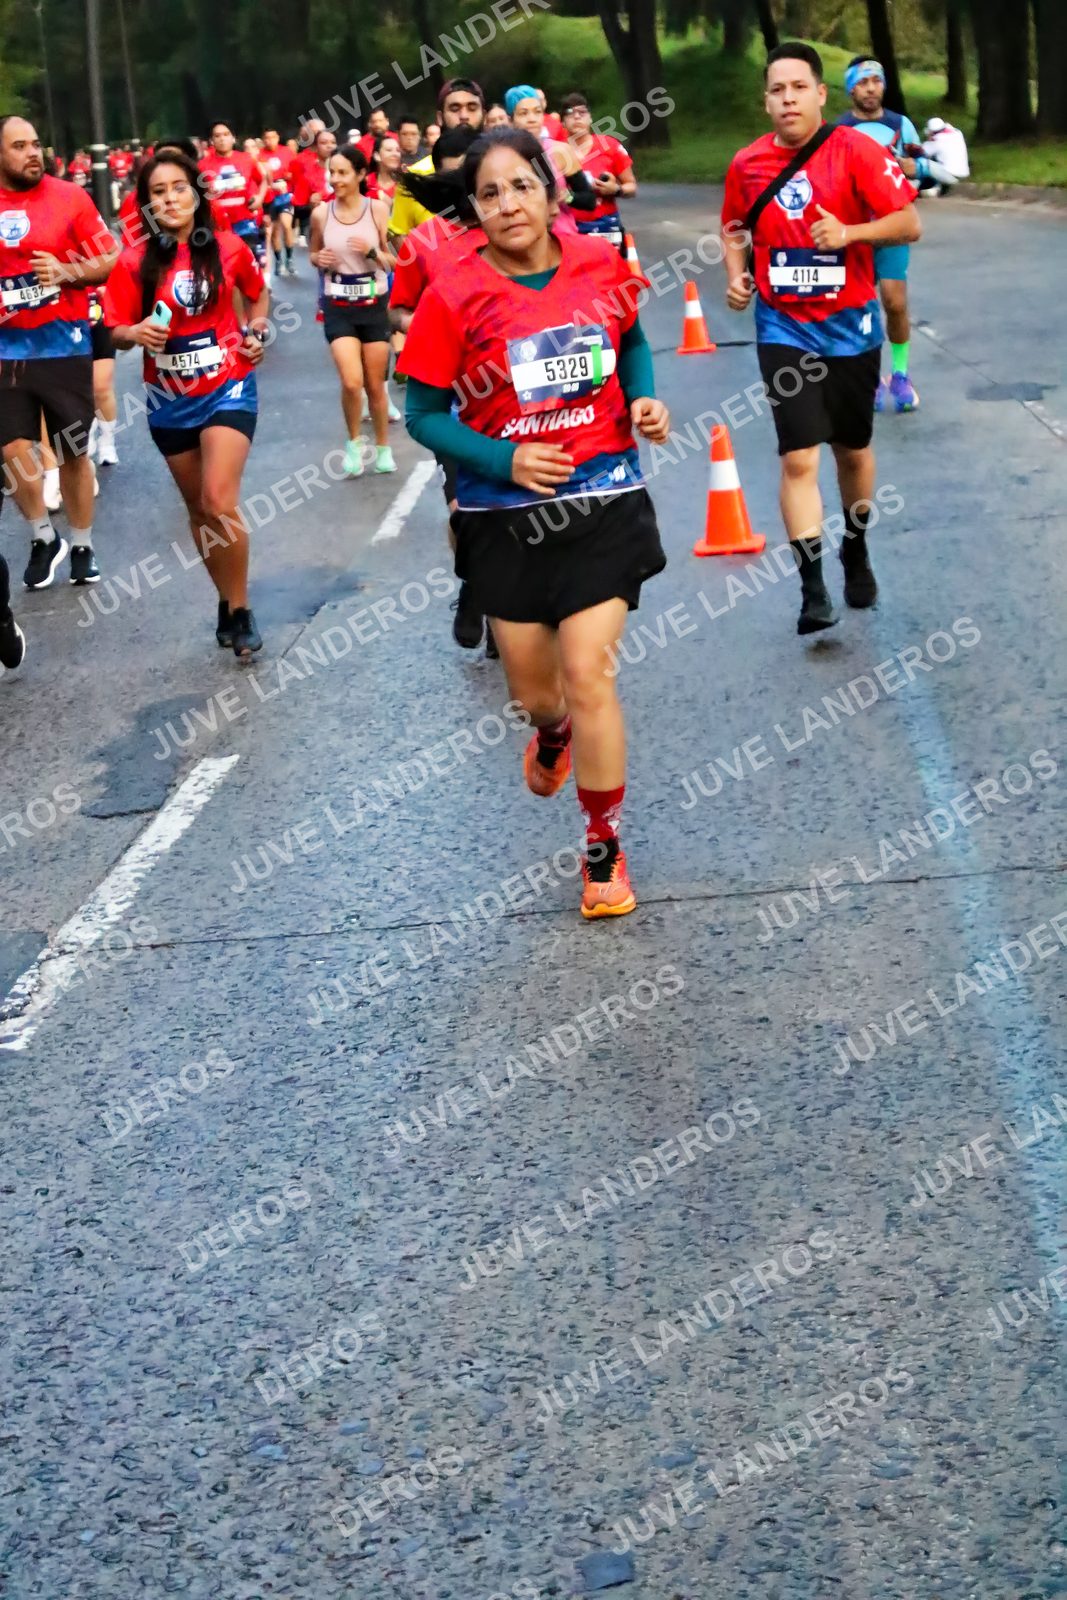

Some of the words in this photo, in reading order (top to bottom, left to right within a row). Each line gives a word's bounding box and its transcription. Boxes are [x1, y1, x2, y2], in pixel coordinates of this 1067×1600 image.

[792, 268, 820, 283] 4114
[20, 285, 45, 301] 4632
[171, 352, 201, 368] 4574
[544, 356, 589, 382] 5329
[500, 404, 595, 438] SANTIAGO
